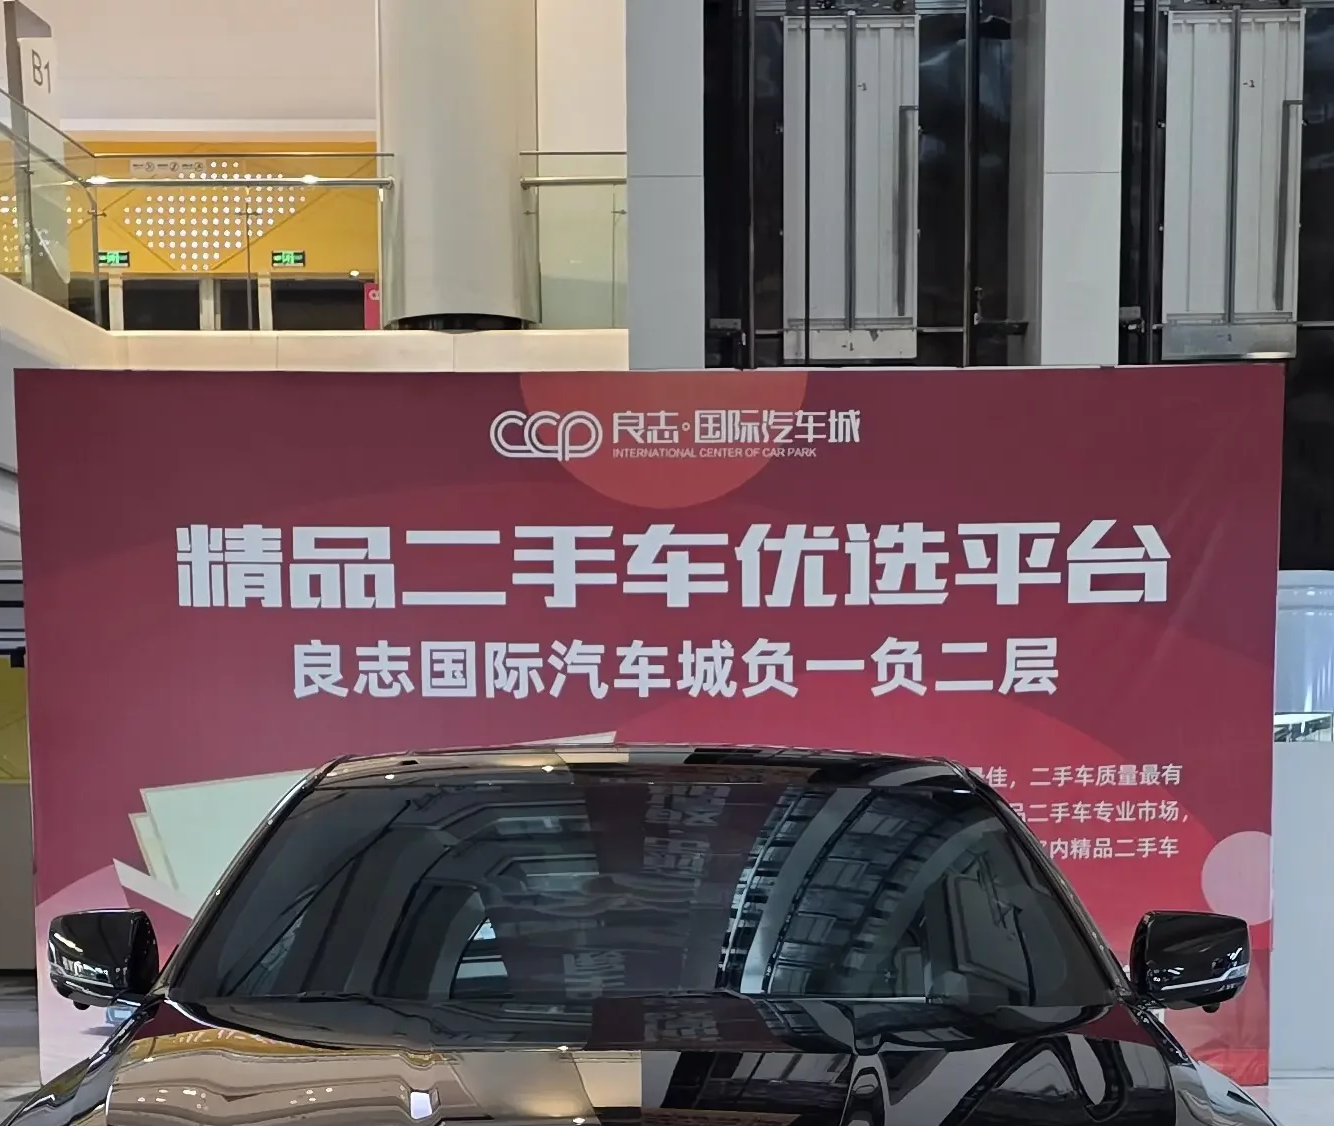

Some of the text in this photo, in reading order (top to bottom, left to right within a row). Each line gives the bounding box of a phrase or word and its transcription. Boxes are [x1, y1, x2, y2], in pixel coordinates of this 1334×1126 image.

[30, 48, 52, 95] B1
[612, 447, 817, 459] INTERNATIONAL CENTER OF CAR PARK
[176, 519, 1172, 609] 精品二手车优选平台
[293, 636, 1059, 700] 良志国际汽车城负一负二层
[1040, 835, 1180, 860] 内精品二手车
